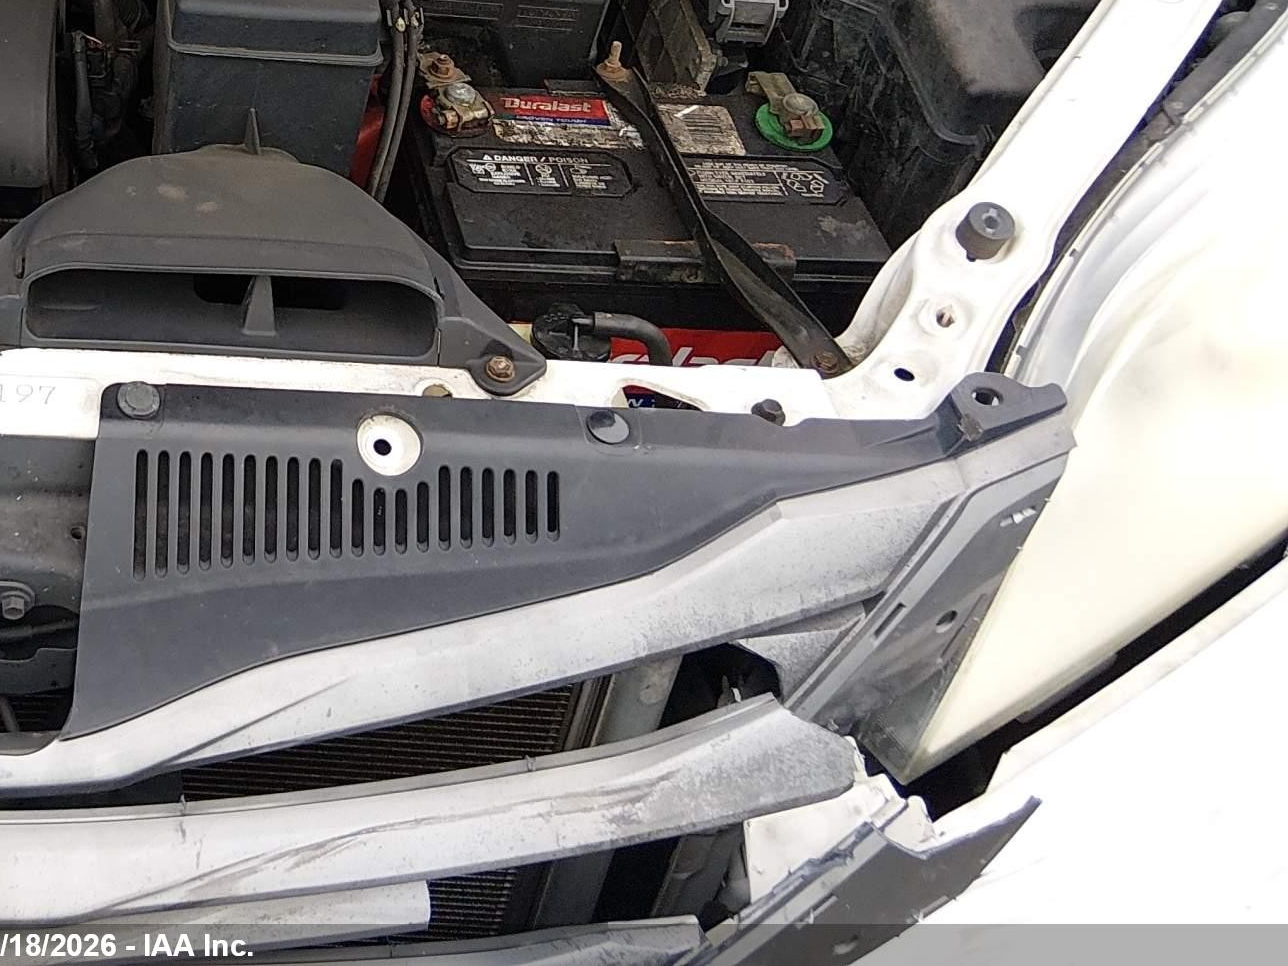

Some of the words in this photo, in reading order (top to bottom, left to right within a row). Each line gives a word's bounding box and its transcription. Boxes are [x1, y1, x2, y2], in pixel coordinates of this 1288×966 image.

[500, 96, 592, 113] Duralast
[494, 155, 538, 163] DANGER
[548, 156, 589, 165] POISON
